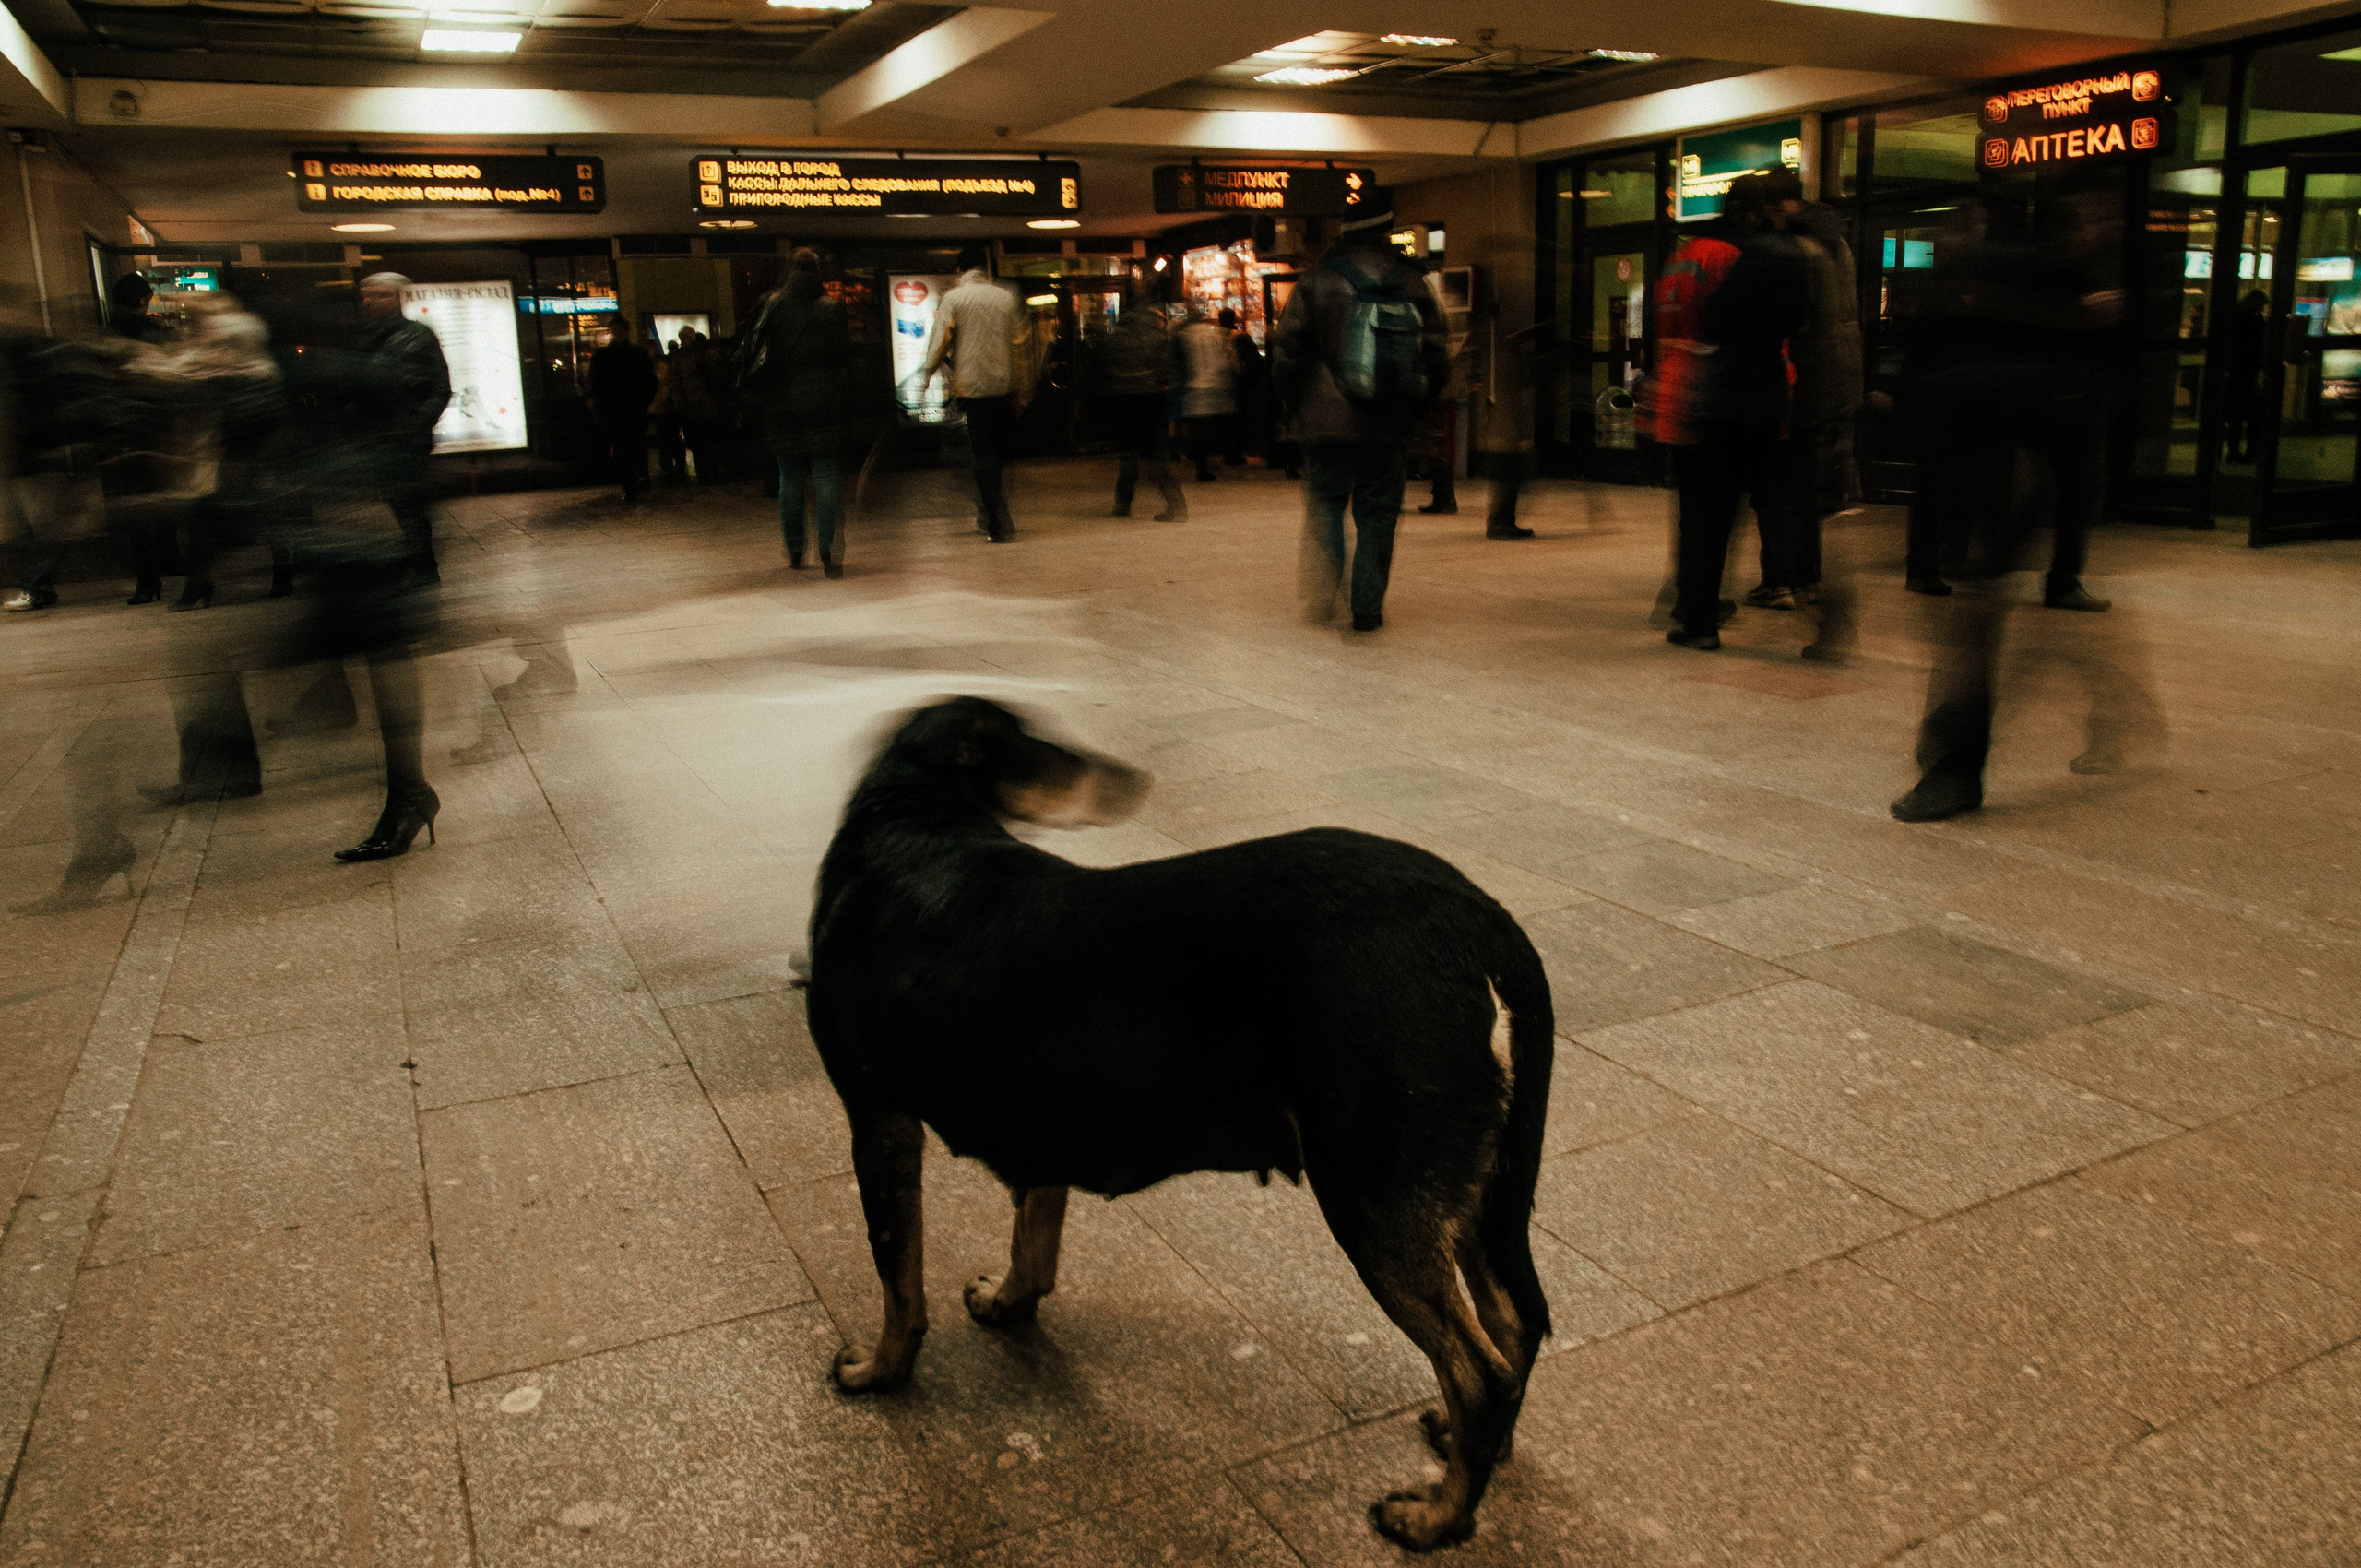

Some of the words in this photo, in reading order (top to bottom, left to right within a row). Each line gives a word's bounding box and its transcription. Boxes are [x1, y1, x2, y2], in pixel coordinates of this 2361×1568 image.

[2007, 72, 2131, 107] ПЕРЕГОВОРНЫЙ
[2042, 97, 2093, 120] ПУНКТ
[2011, 124, 2126, 165] АПТЕКА
[329, 163, 433, 178] СПРАВОЧНОЕ
[433, 164, 481, 179] БЮРО
[727, 160, 780, 176] ВЫХОД
[780, 161, 792, 175] В
[793, 162, 841, 177] ГОРОД
[728, 176, 778, 190] КАССЫ
[778, 177, 850, 192] ДАЛЬНЕГО
[851, 178, 940, 193] СЛЕДОВАНИЯ
[1204, 172, 1291, 189] МЕДПУНКТ
[332, 186, 424, 201] ГОРОДСКАЯ
[424, 187, 494, 201] СПРАВКА
[729, 192, 833, 208] ПРИГОРОДНЫЕ
[833, 193, 882, 207] КАССЫ
[1204, 191, 1284, 209] МИЛИЦИЯ
